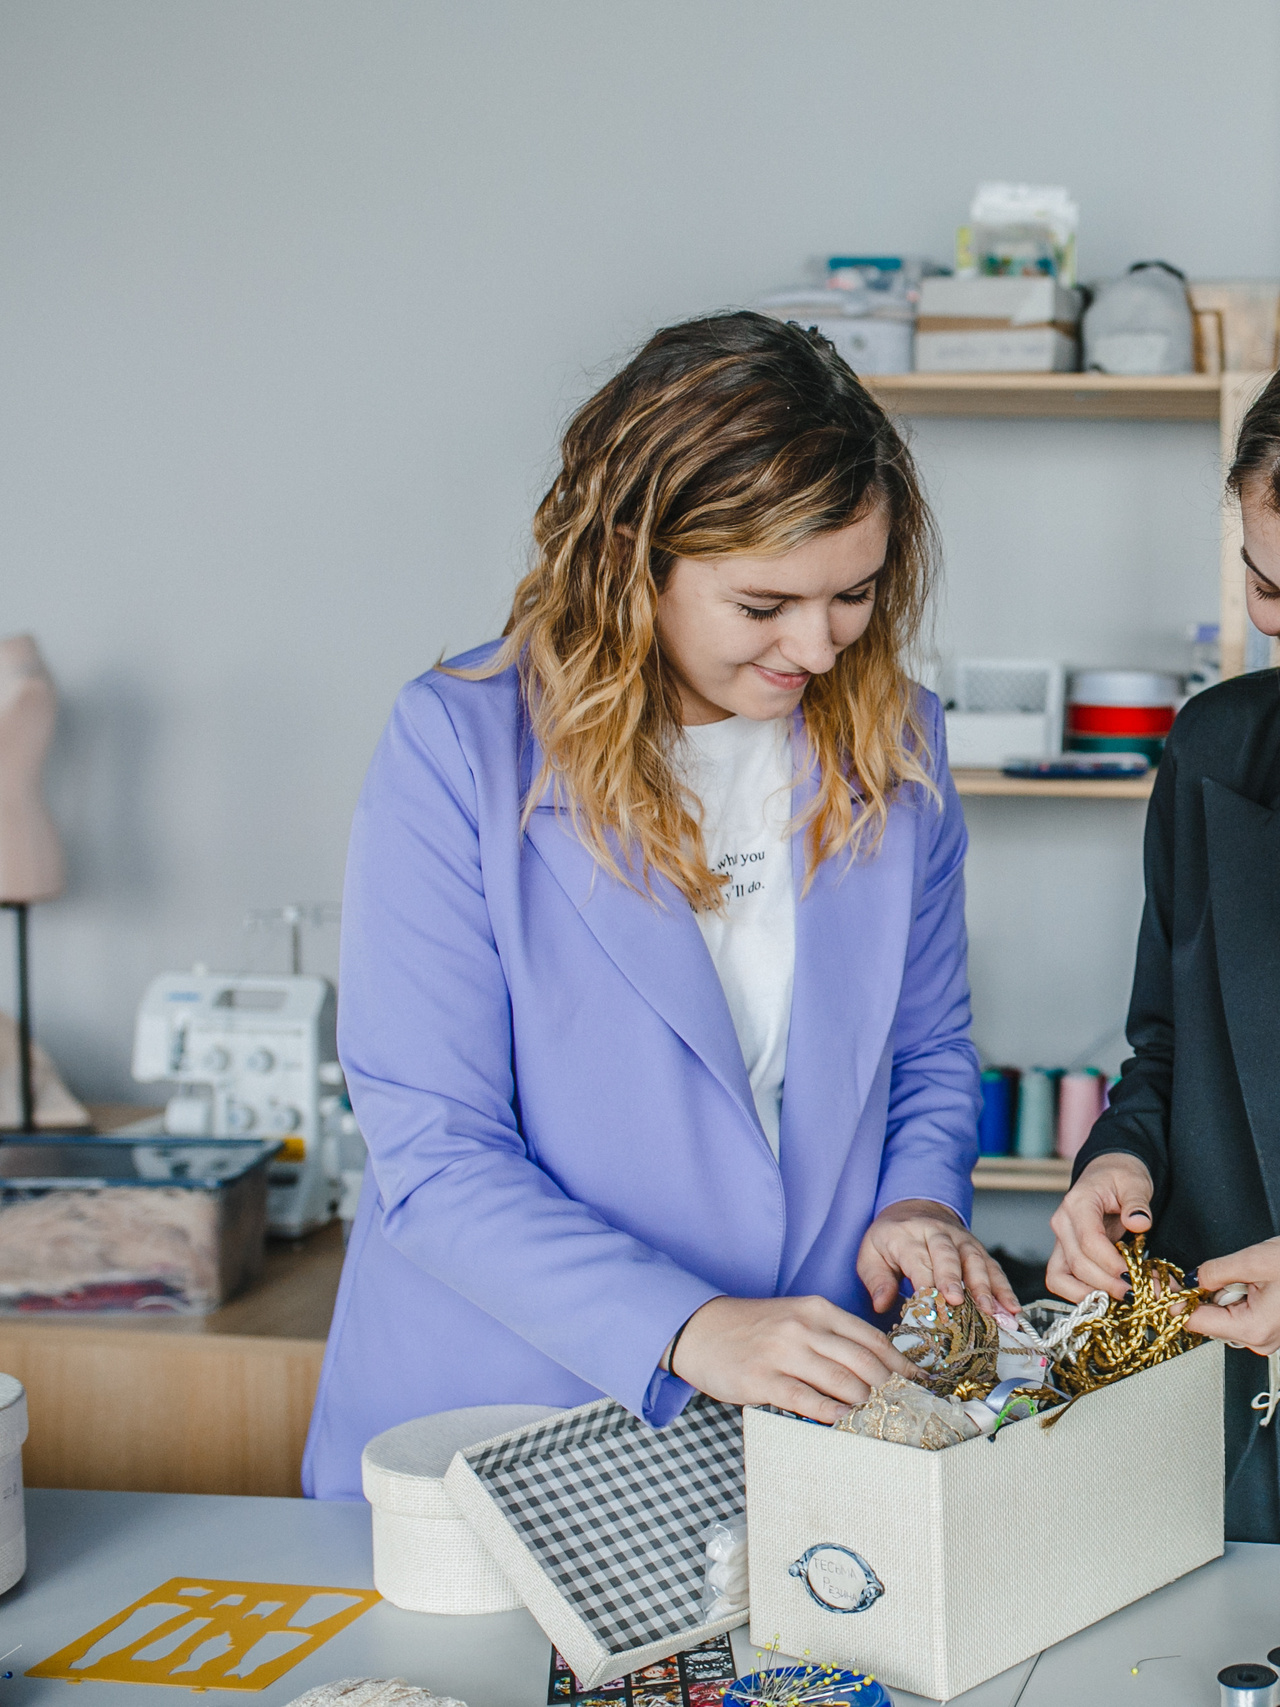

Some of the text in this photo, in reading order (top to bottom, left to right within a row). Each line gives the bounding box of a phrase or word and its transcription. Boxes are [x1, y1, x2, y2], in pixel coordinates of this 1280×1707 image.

[740, 851, 765, 867] you
[747, 881, 765, 894] do.
[813, 1557, 857, 1580] ТЕСЬМА
